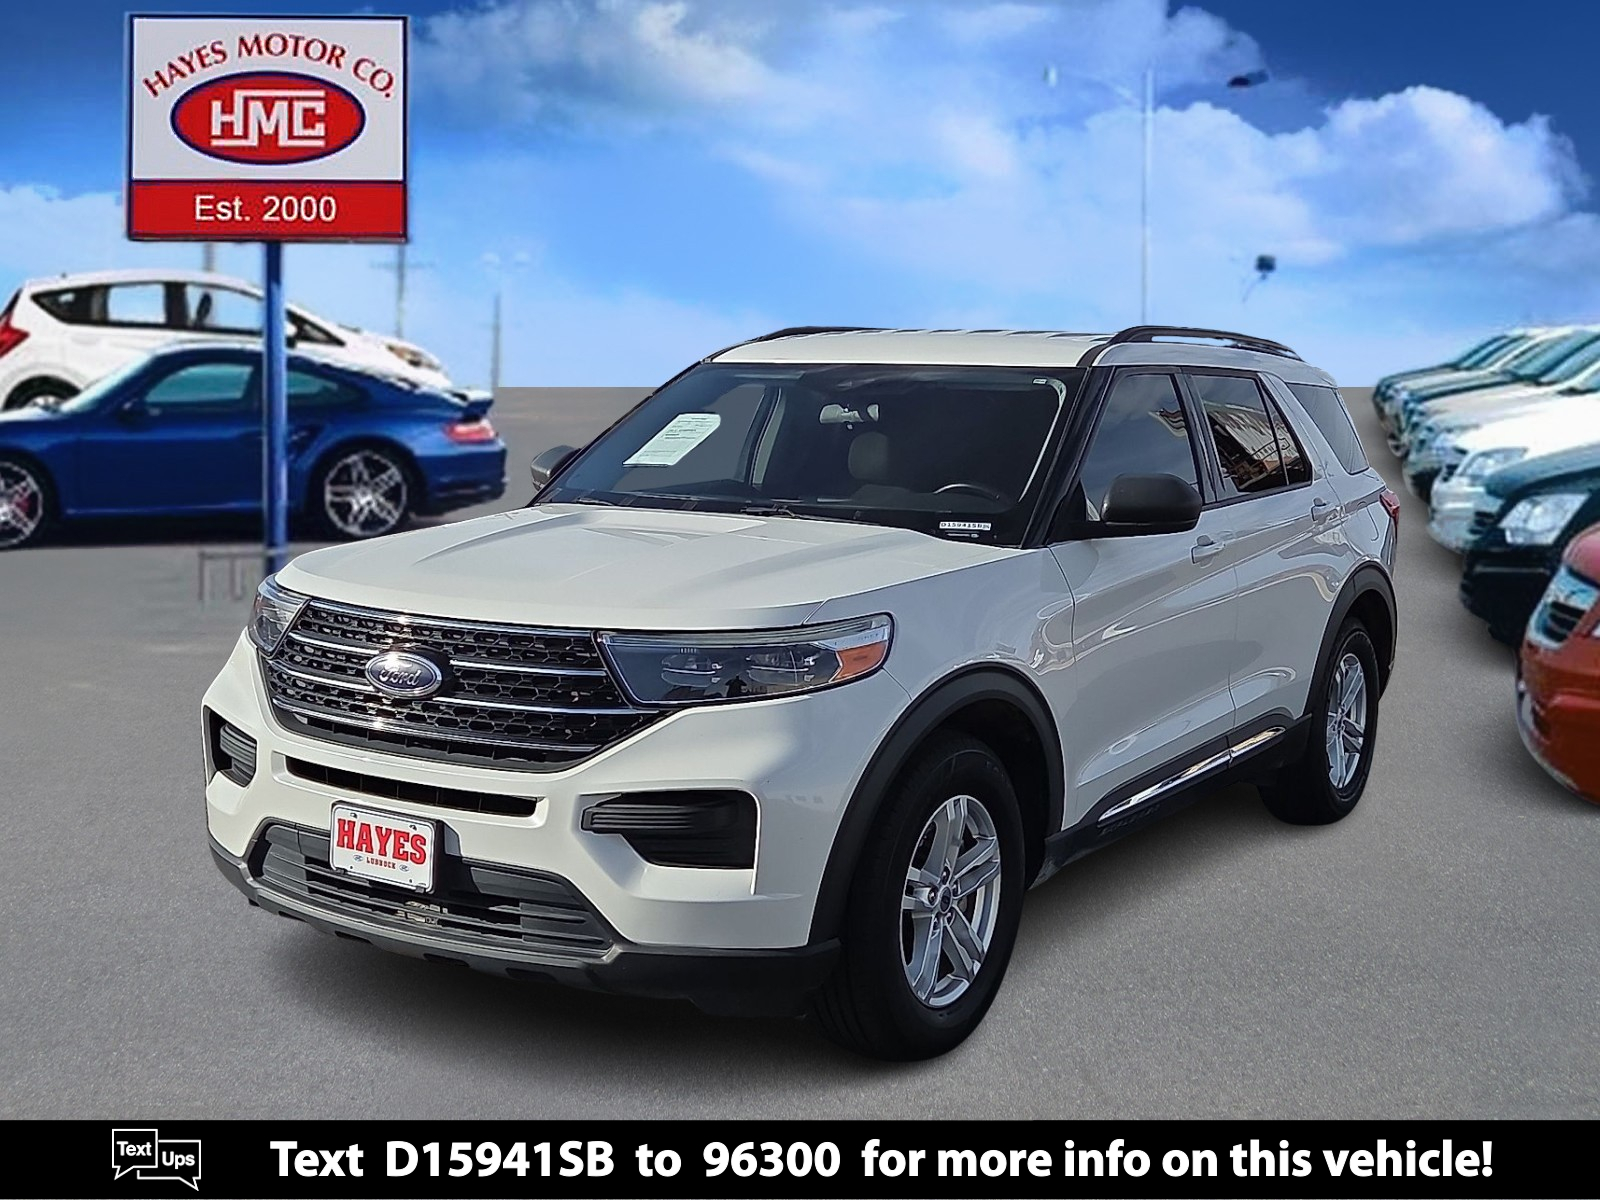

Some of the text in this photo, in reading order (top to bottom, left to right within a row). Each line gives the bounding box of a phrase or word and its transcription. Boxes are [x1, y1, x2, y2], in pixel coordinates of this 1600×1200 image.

[142, 32, 395, 98] HAYES MOTOR CO.
[210, 89, 326, 147] HMC
[194, 195, 337, 222] Est. 2000
[379, 665, 422, 686] Ford
[336, 818, 427, 865] HAYES
